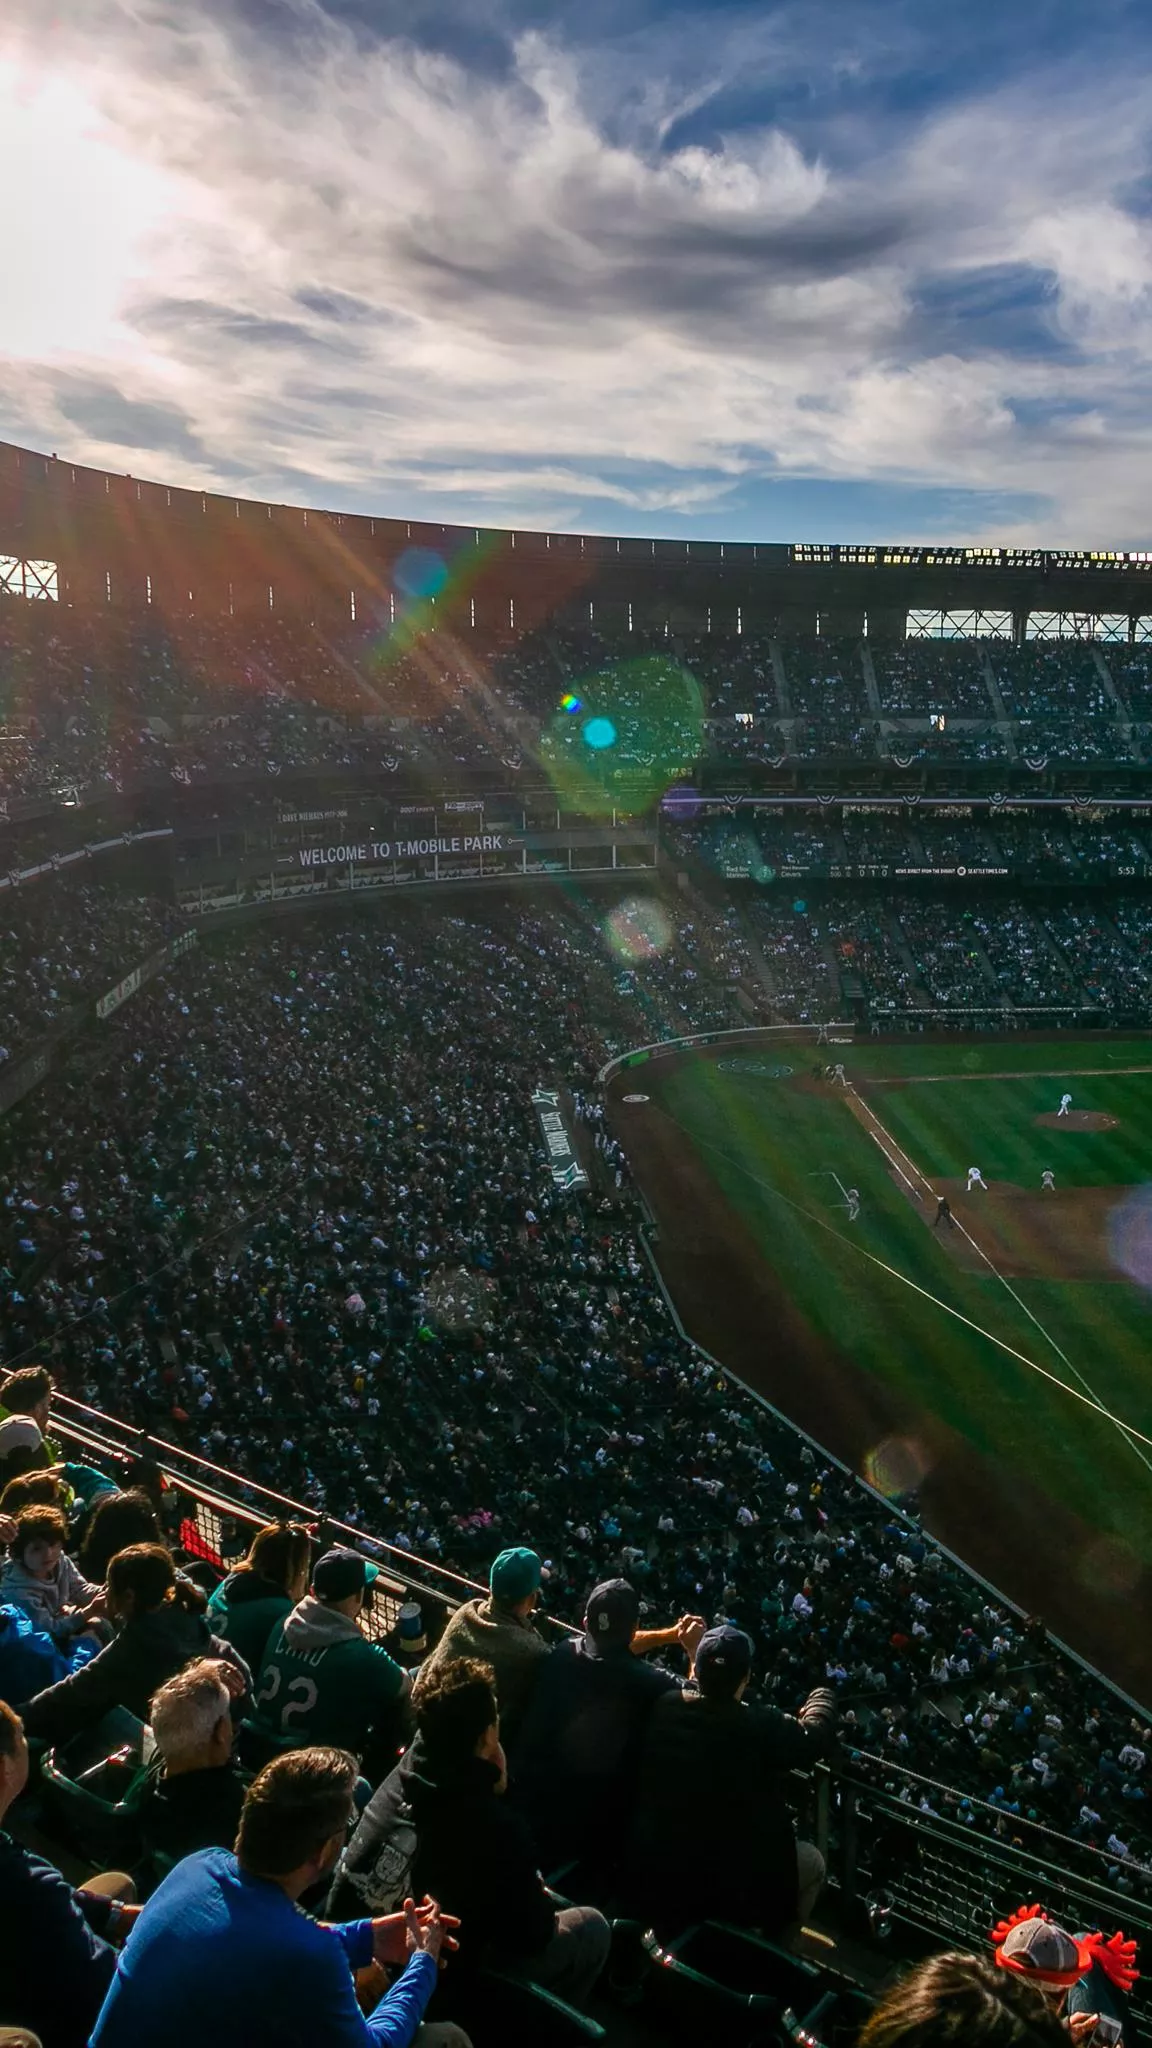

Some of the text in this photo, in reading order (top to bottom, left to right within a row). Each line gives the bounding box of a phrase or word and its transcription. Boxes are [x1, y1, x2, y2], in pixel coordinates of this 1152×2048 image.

[299, 835, 503, 866] WELCOME TO T-MOBILE PARK
[1118, 866, 1136, 876] 5:53
[255, 1664, 319, 1737] 22
